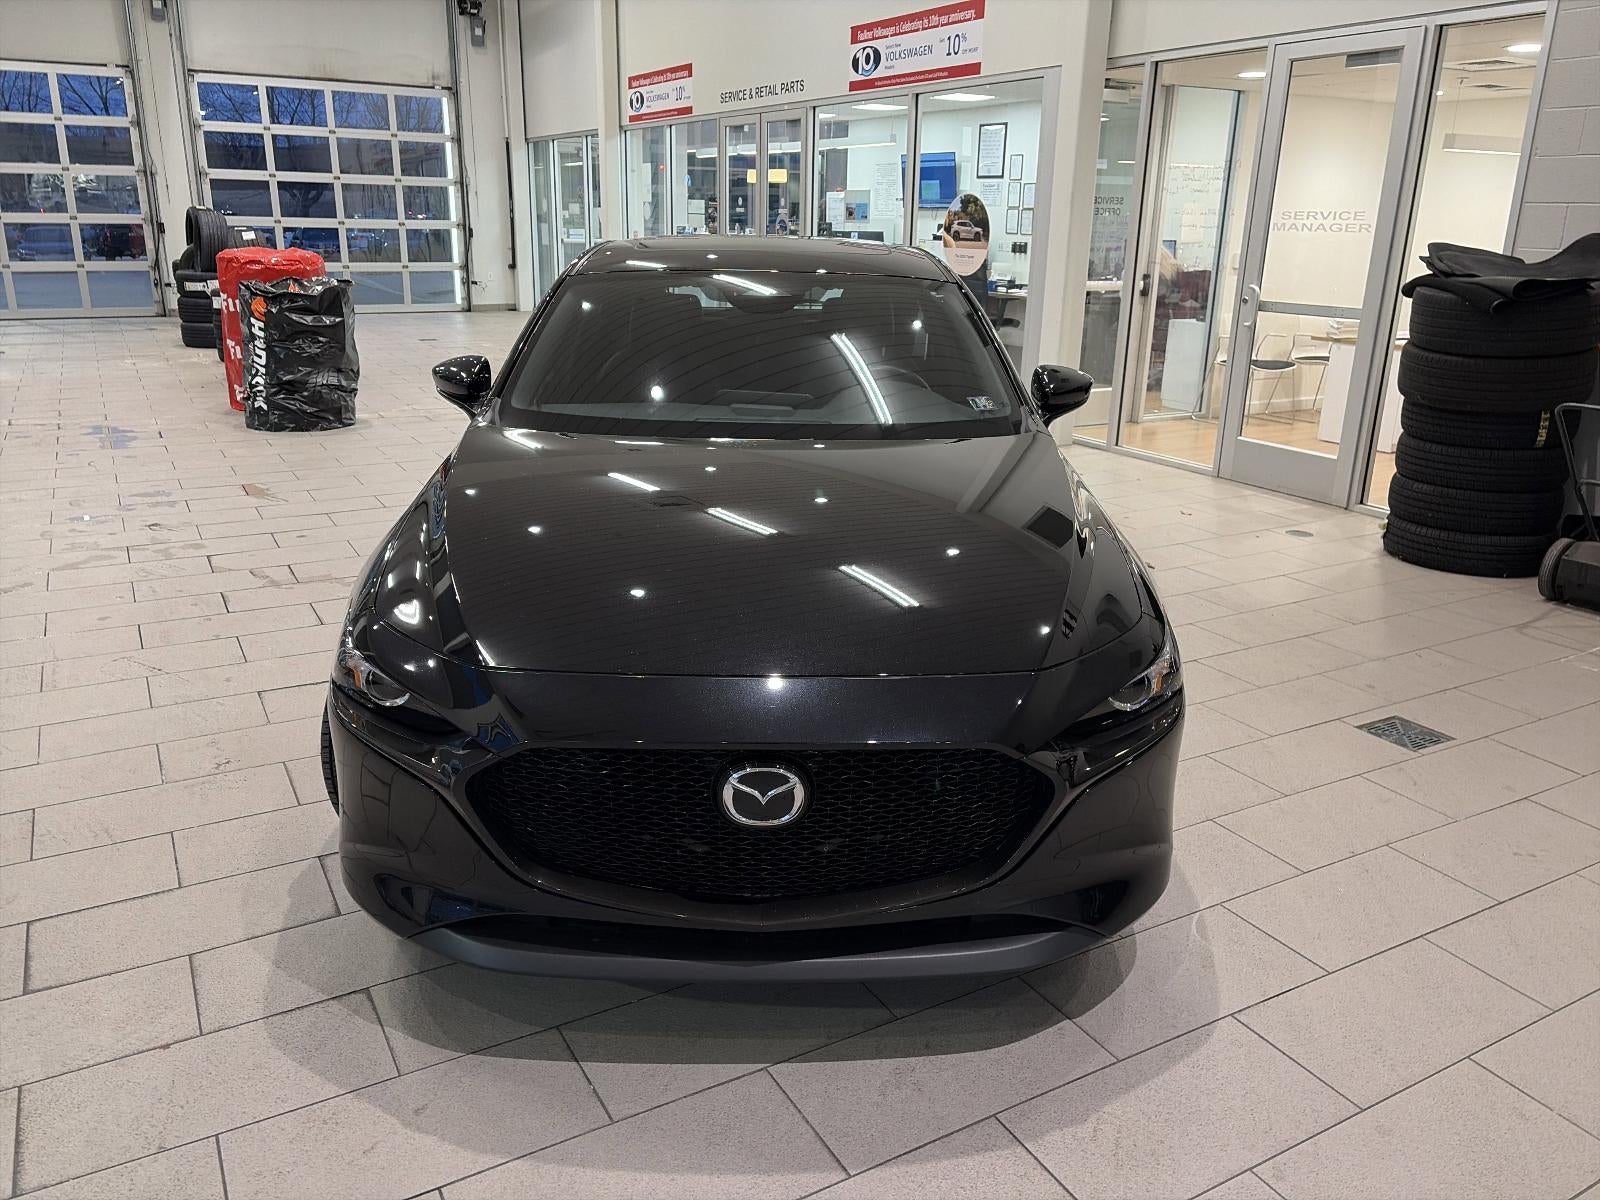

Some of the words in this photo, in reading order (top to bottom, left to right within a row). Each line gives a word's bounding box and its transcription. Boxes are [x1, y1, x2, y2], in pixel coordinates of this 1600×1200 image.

[873, 26, 896, 38] Volkswagen
[900, 19, 922, 32] Celebrating
[885, 44, 934, 62] VOLKSWAGEN
[720, 89, 747, 104] SERVICE
[748, 87, 753, 100] &
[755, 83, 778, 99] RETAIL
[780, 79, 805, 95] PARTS
[1281, 210, 1367, 221] SERVICE
[1272, 222, 1372, 233] MANAGER
